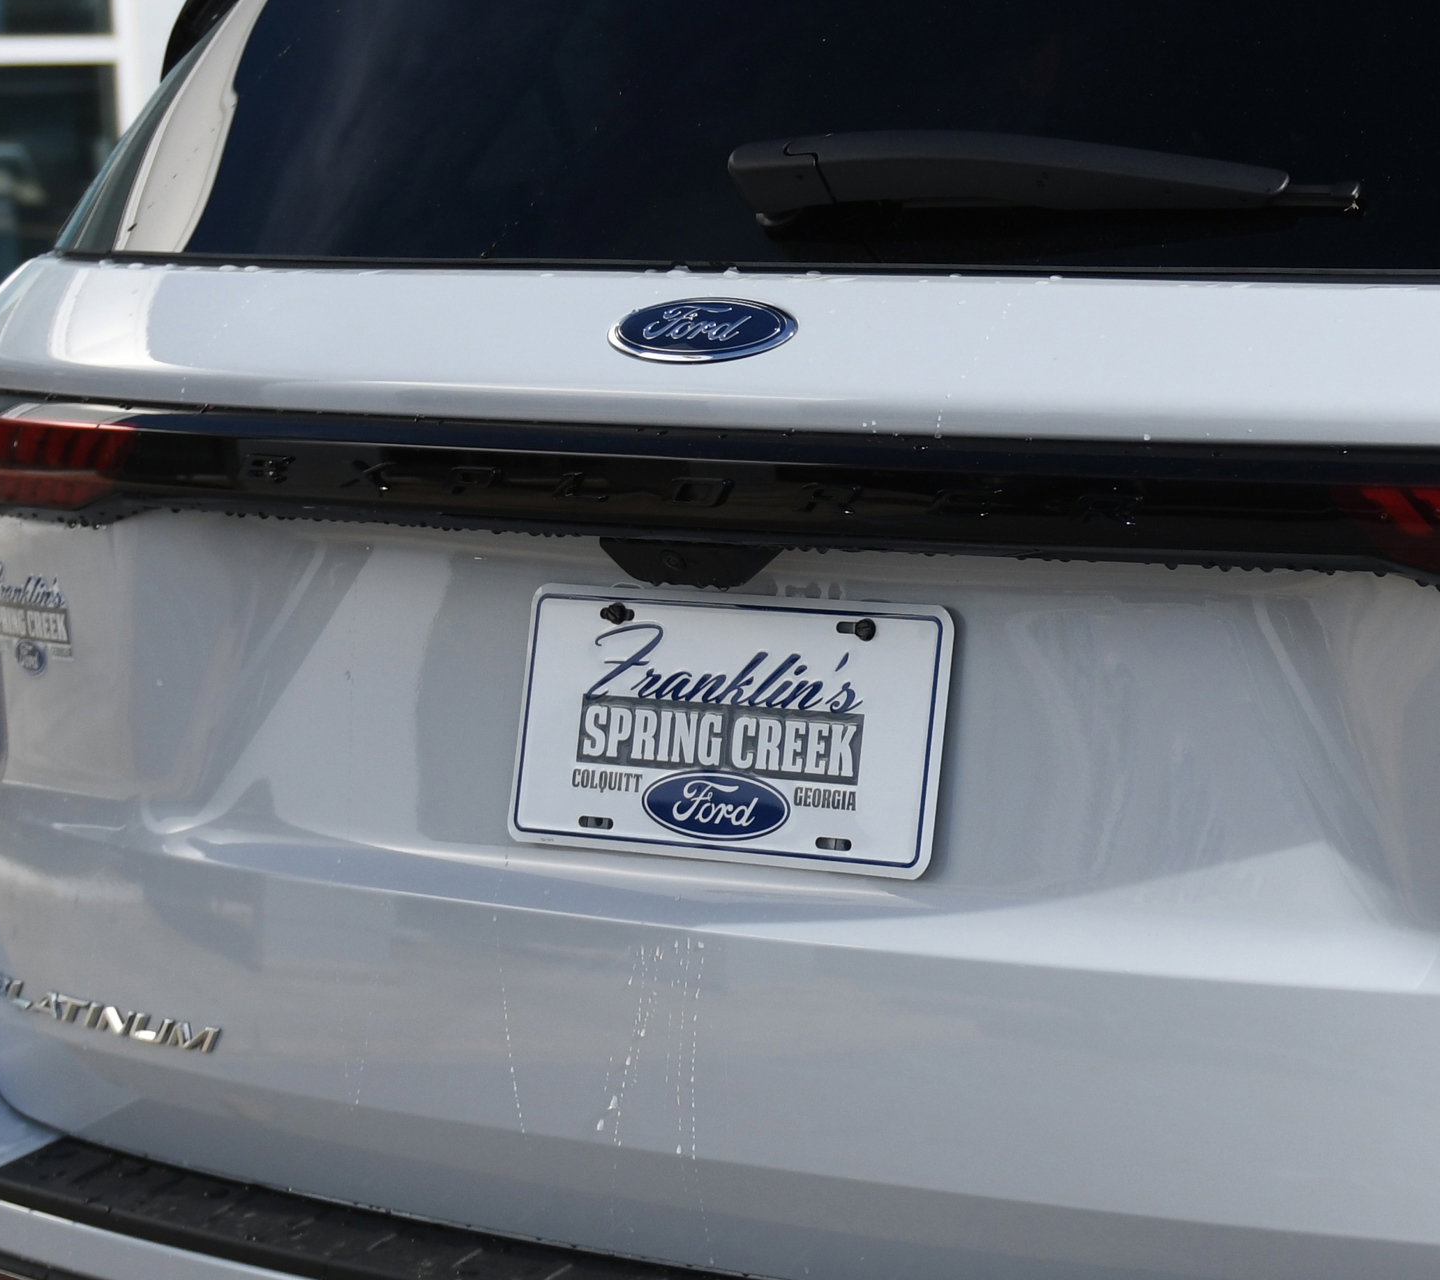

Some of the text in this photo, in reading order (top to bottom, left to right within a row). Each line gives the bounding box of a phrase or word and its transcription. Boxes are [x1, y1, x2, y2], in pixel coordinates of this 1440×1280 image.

[643, 306, 752, 341] Ford
[26, 610, 68, 641] CREEK
[586, 623, 864, 713] Franklin's
[582, 705, 858, 778] SPRING CREEK
[572, 769, 643, 793] COLQUITT
[793, 786, 857, 811] GEORGIA
[672, 780, 759, 828] Ford
